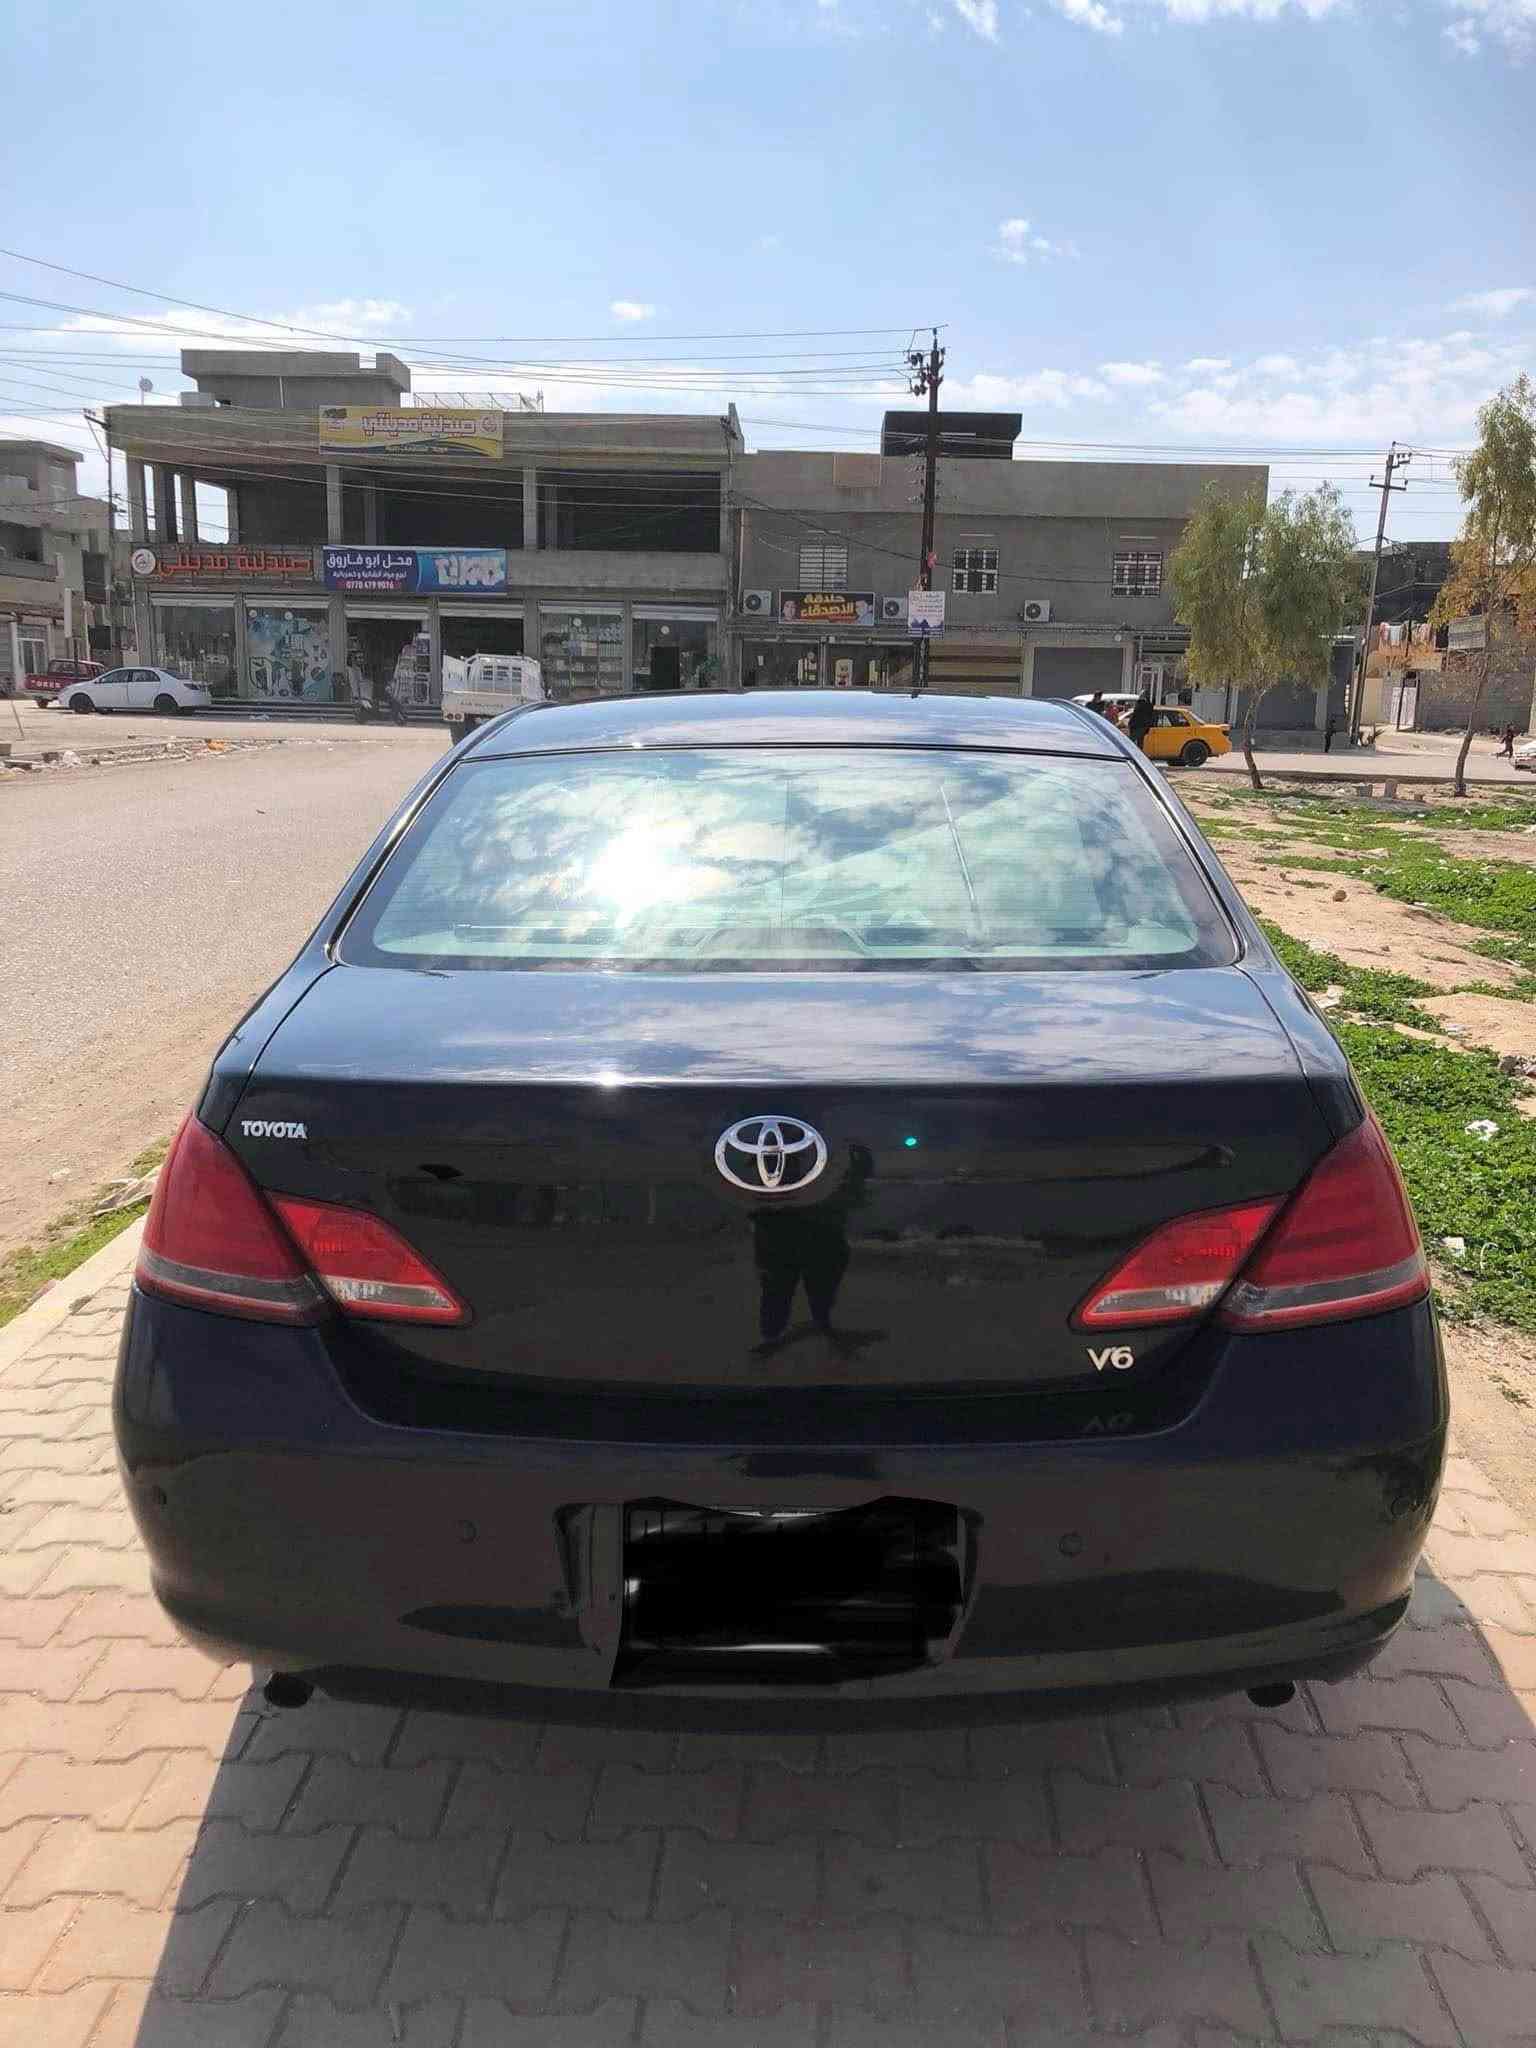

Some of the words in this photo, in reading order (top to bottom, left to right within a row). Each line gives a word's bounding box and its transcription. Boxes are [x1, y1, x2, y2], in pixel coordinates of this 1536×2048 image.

[237, 547, 313, 577] صيدلية
[326, 553, 363, 568] فاروق
[383, 553, 413, 568] محل
[241, 1120, 307, 1139] TOYOTA
[1086, 1346, 1134, 1370] V6
